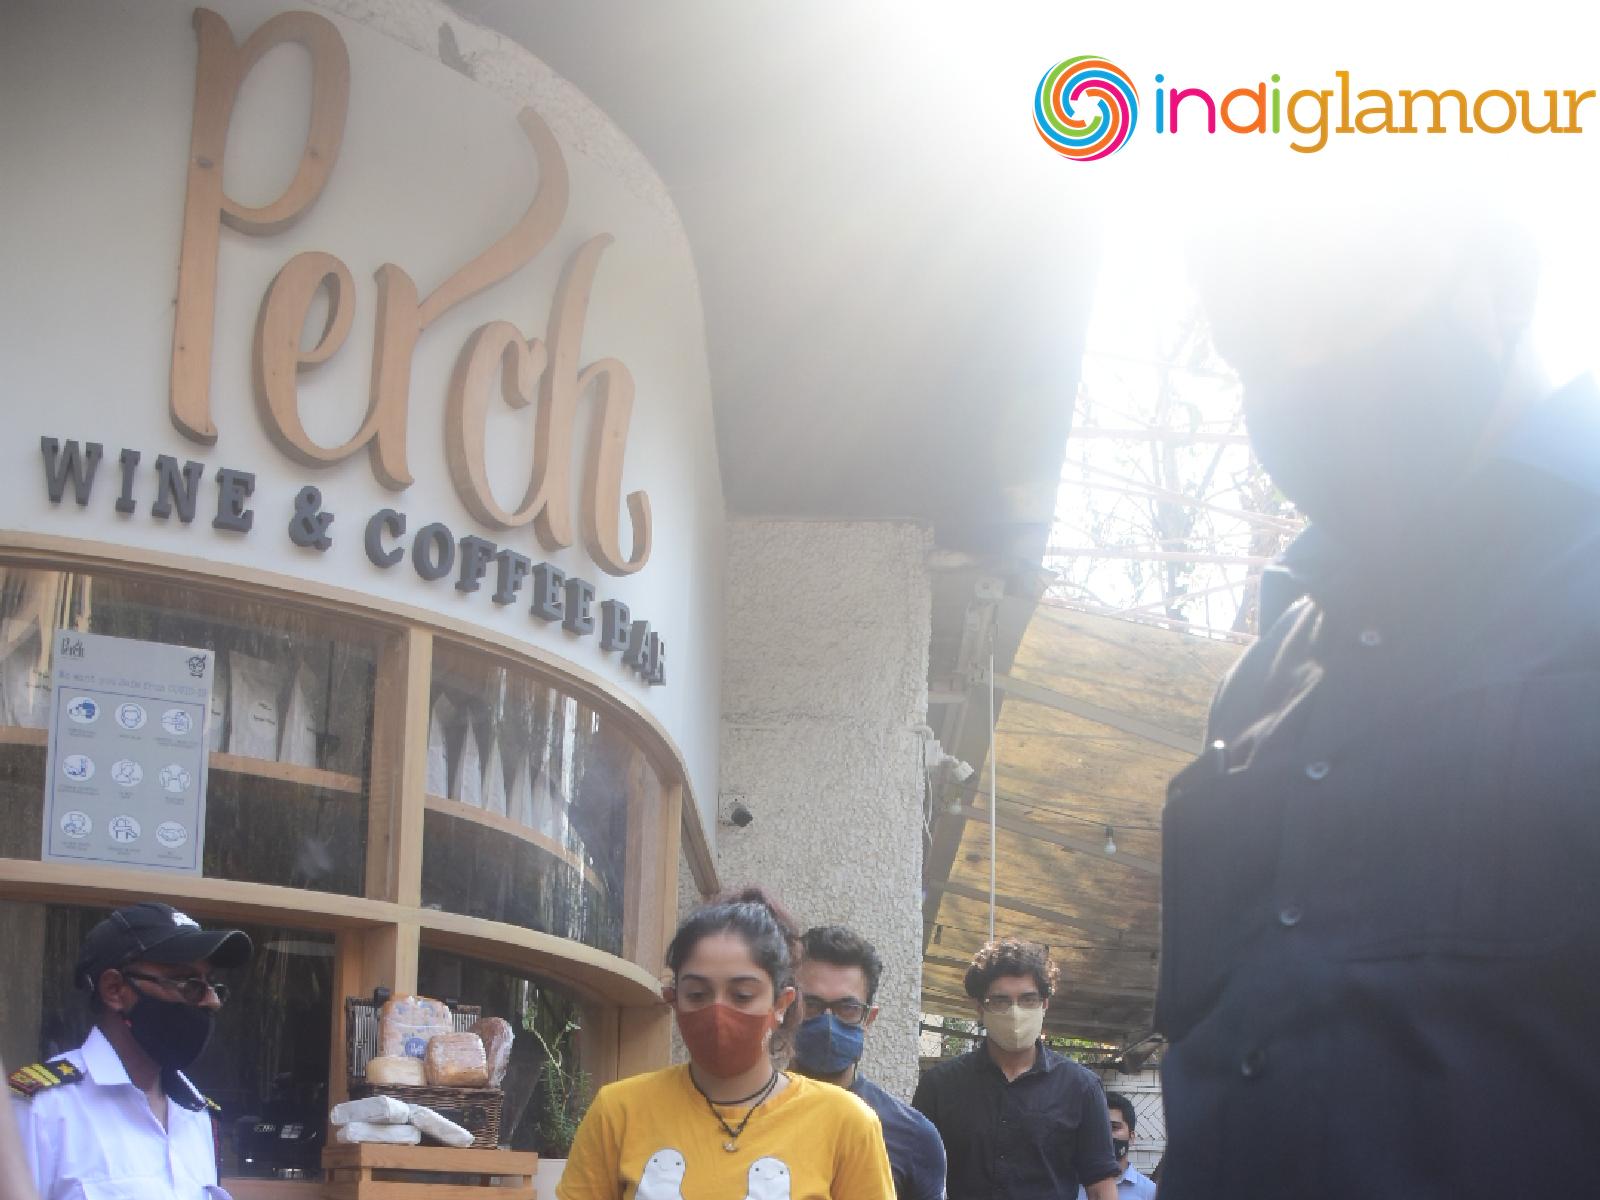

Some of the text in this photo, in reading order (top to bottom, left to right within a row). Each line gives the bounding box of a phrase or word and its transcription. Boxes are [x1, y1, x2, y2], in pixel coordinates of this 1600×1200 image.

[169, 6, 652, 577] Perch
[41, 436, 666, 686] WINE & COFFEE BAR
